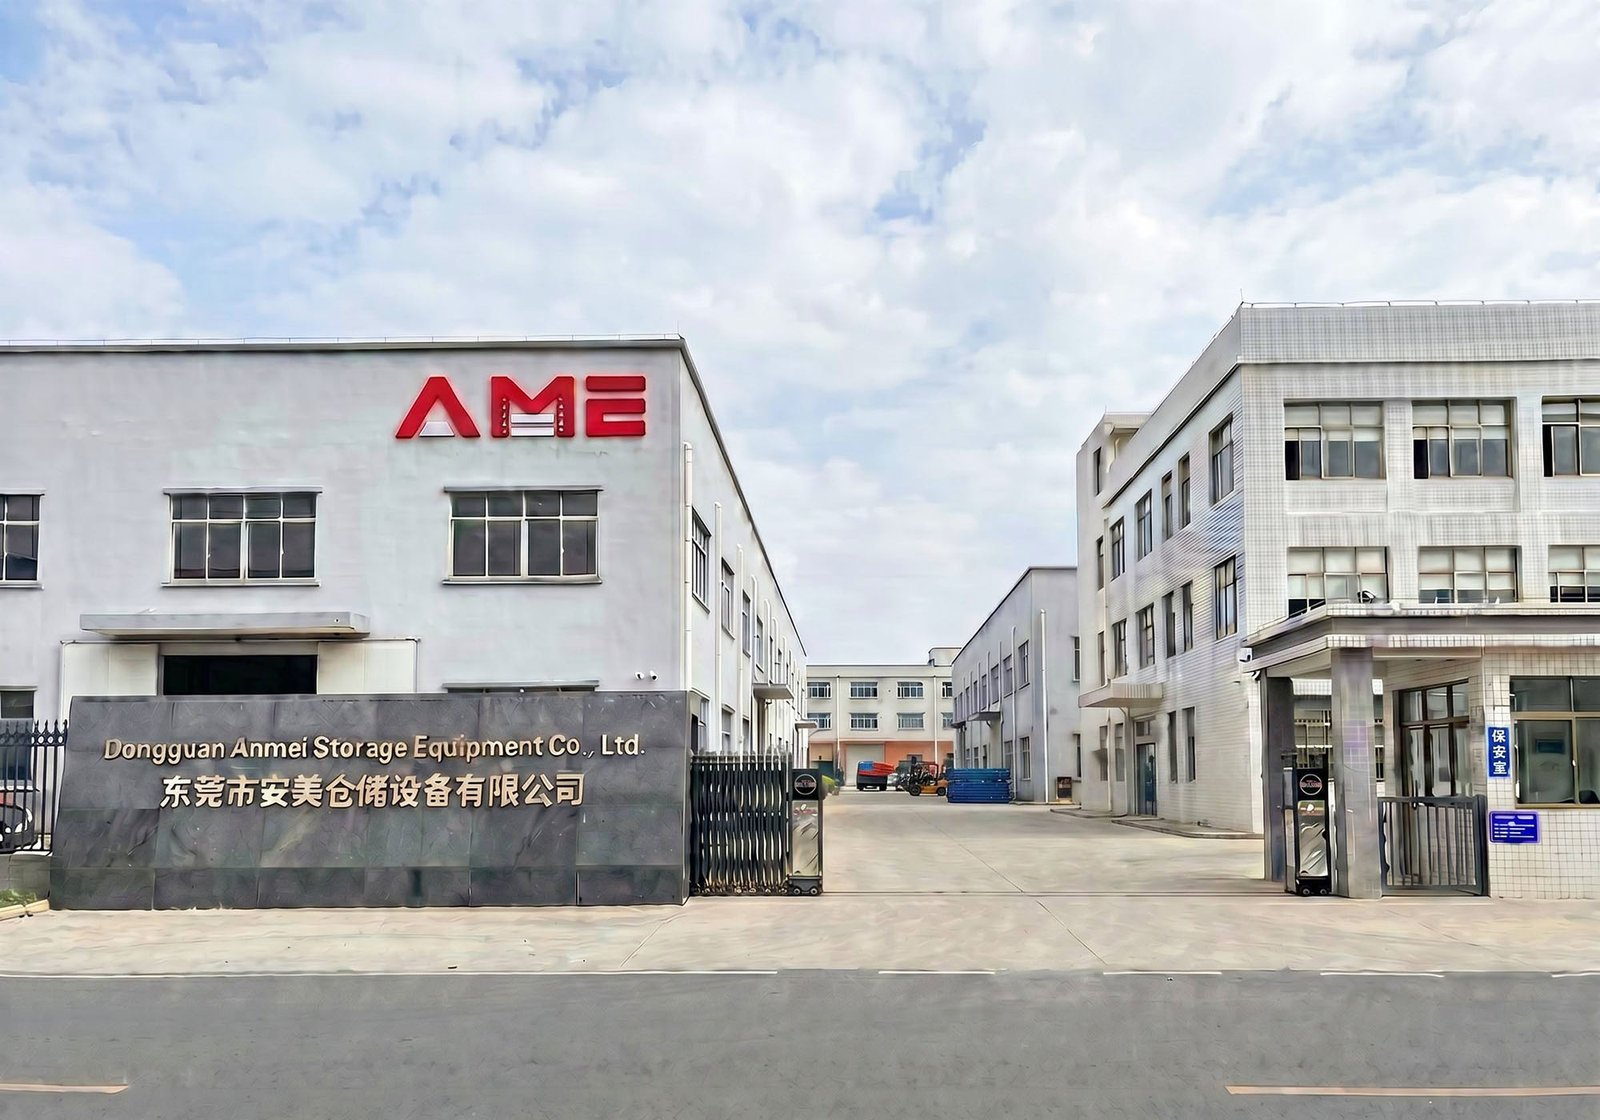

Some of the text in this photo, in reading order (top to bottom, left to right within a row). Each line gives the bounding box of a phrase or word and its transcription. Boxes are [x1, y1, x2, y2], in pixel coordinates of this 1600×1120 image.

[395, 376, 646, 438] AME
[104, 733, 646, 765] Dongguan Anmei Storage Equipment Co., Ltd.
[1491, 729, 1507, 775] 保安室
[160, 772, 585, 808] 东莞市安美仓储设备有限公司
